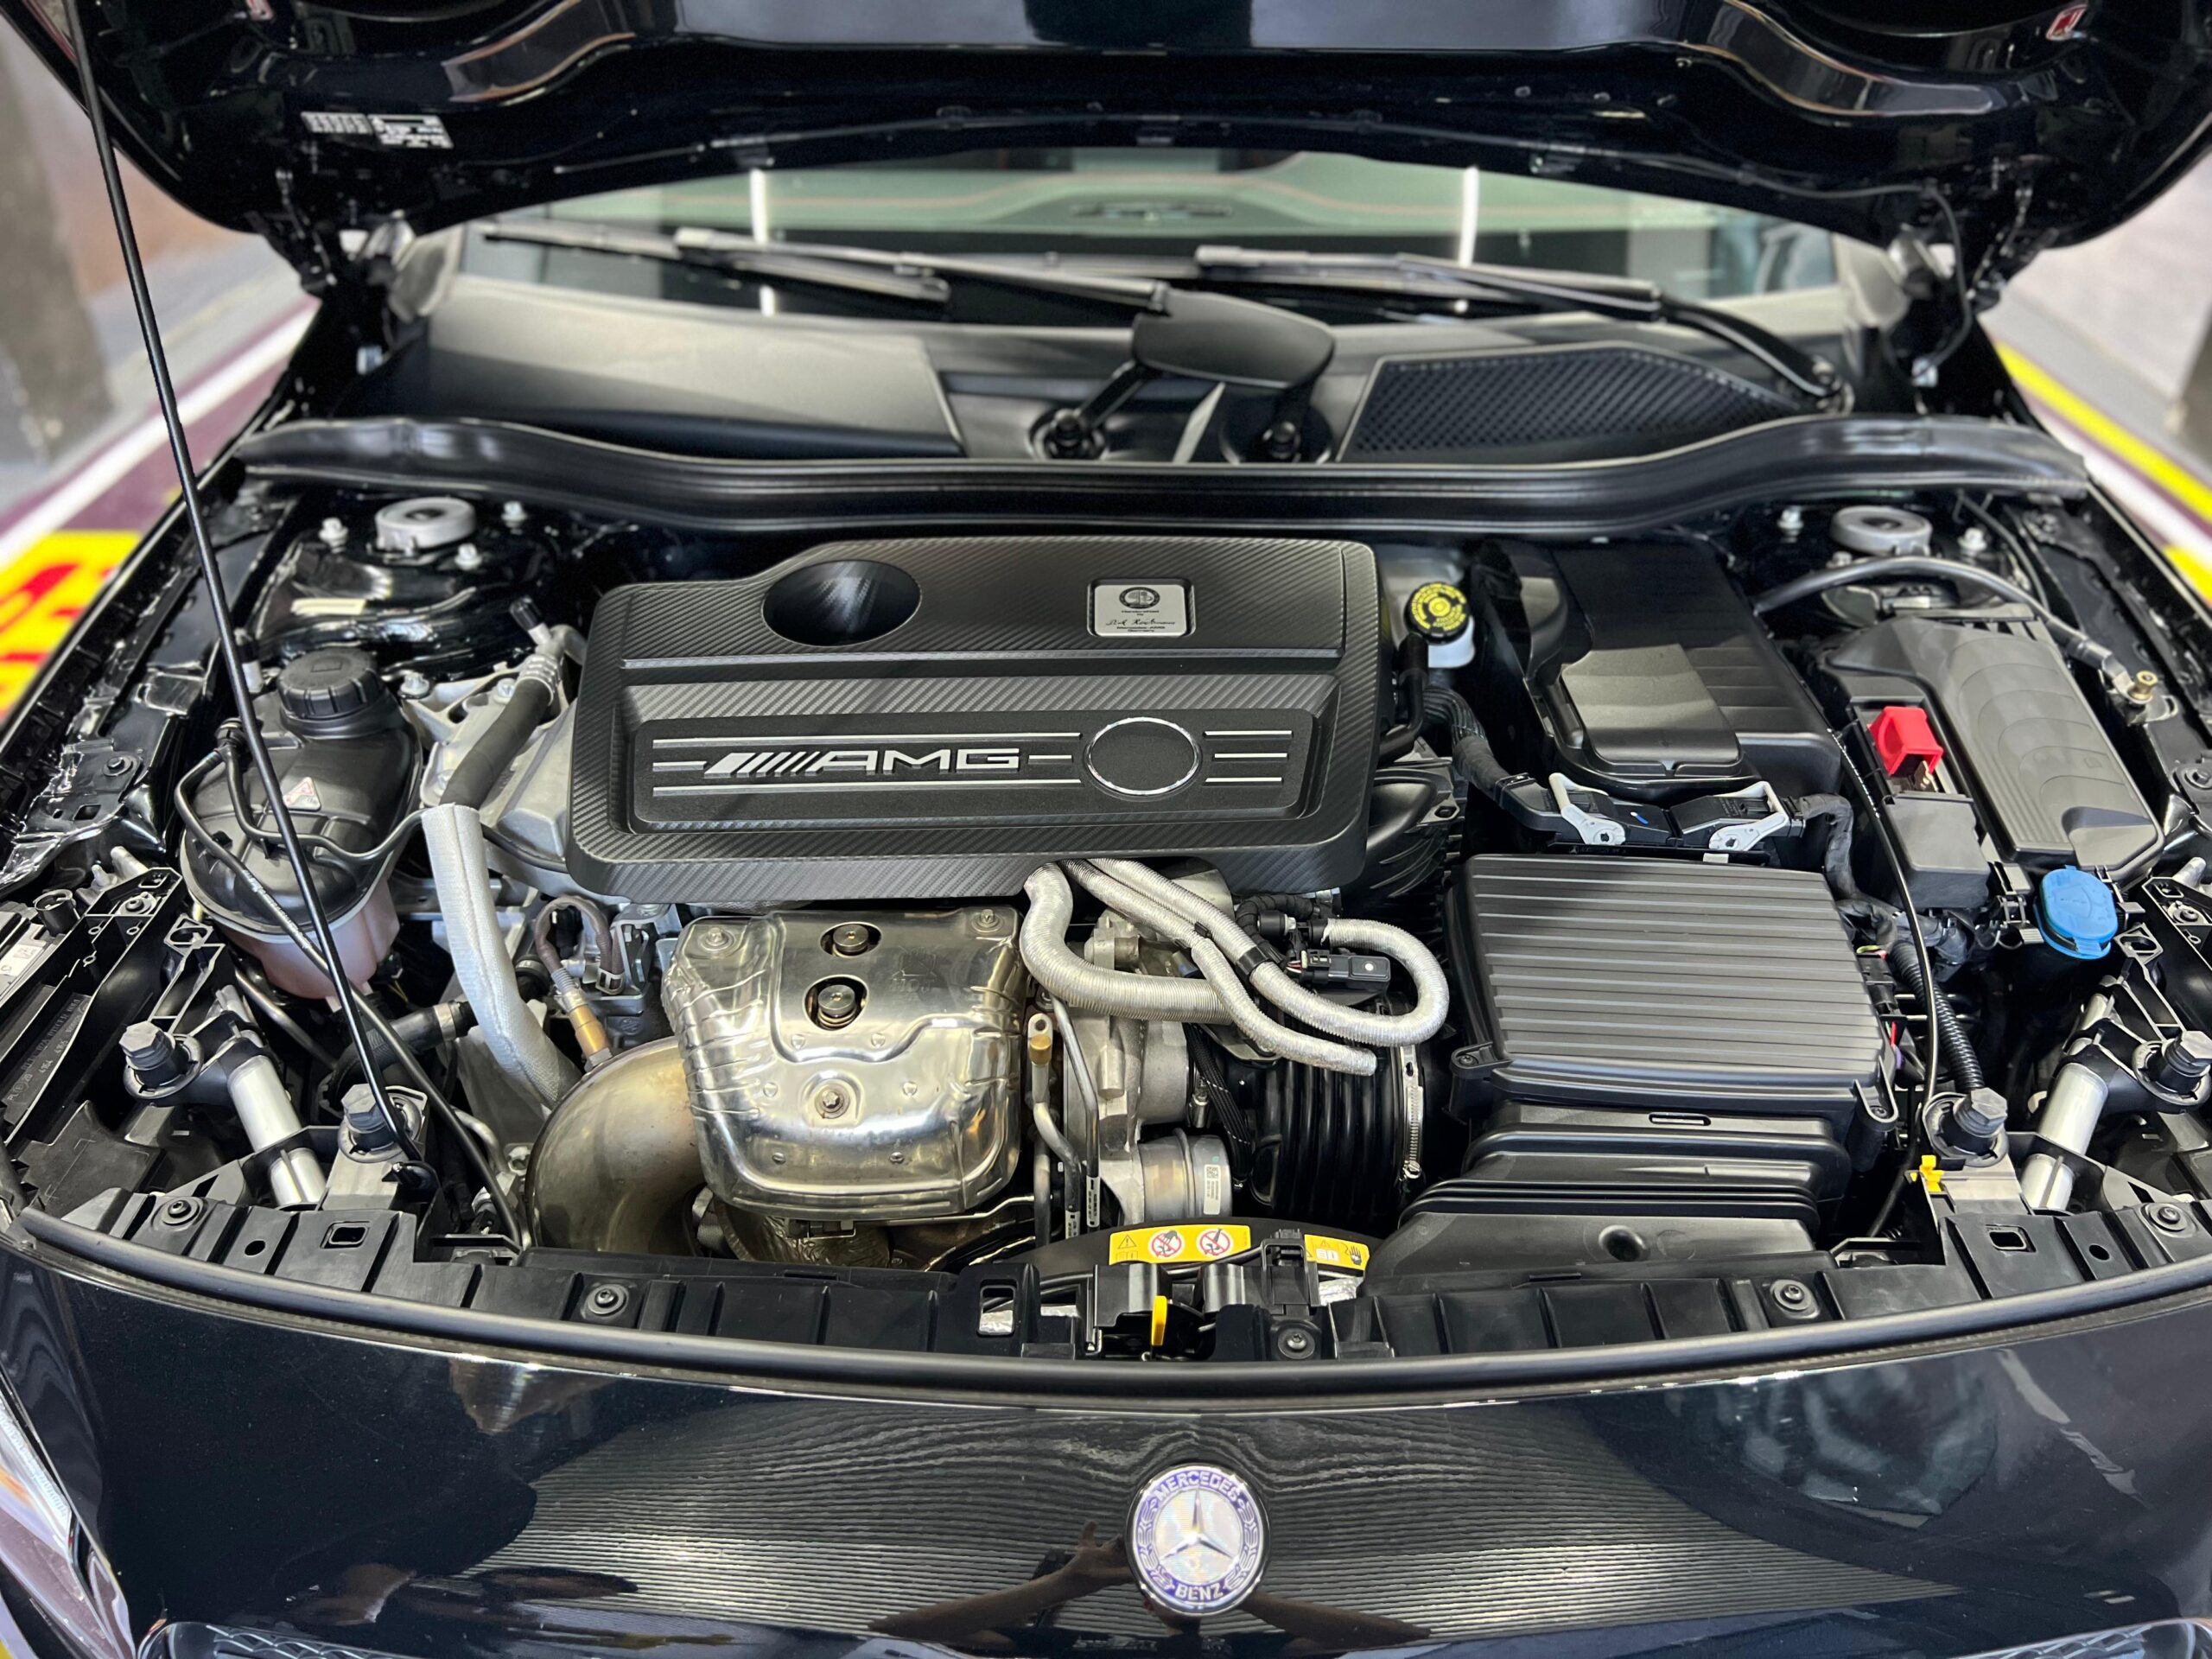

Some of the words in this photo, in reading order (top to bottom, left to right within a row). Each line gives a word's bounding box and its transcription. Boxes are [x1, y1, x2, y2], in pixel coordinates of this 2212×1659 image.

[804, 747, 1020, 776] AMG
[1154, 1471, 1242, 1502] MERCEDES
[1174, 1582, 1224, 1600] BENZ
